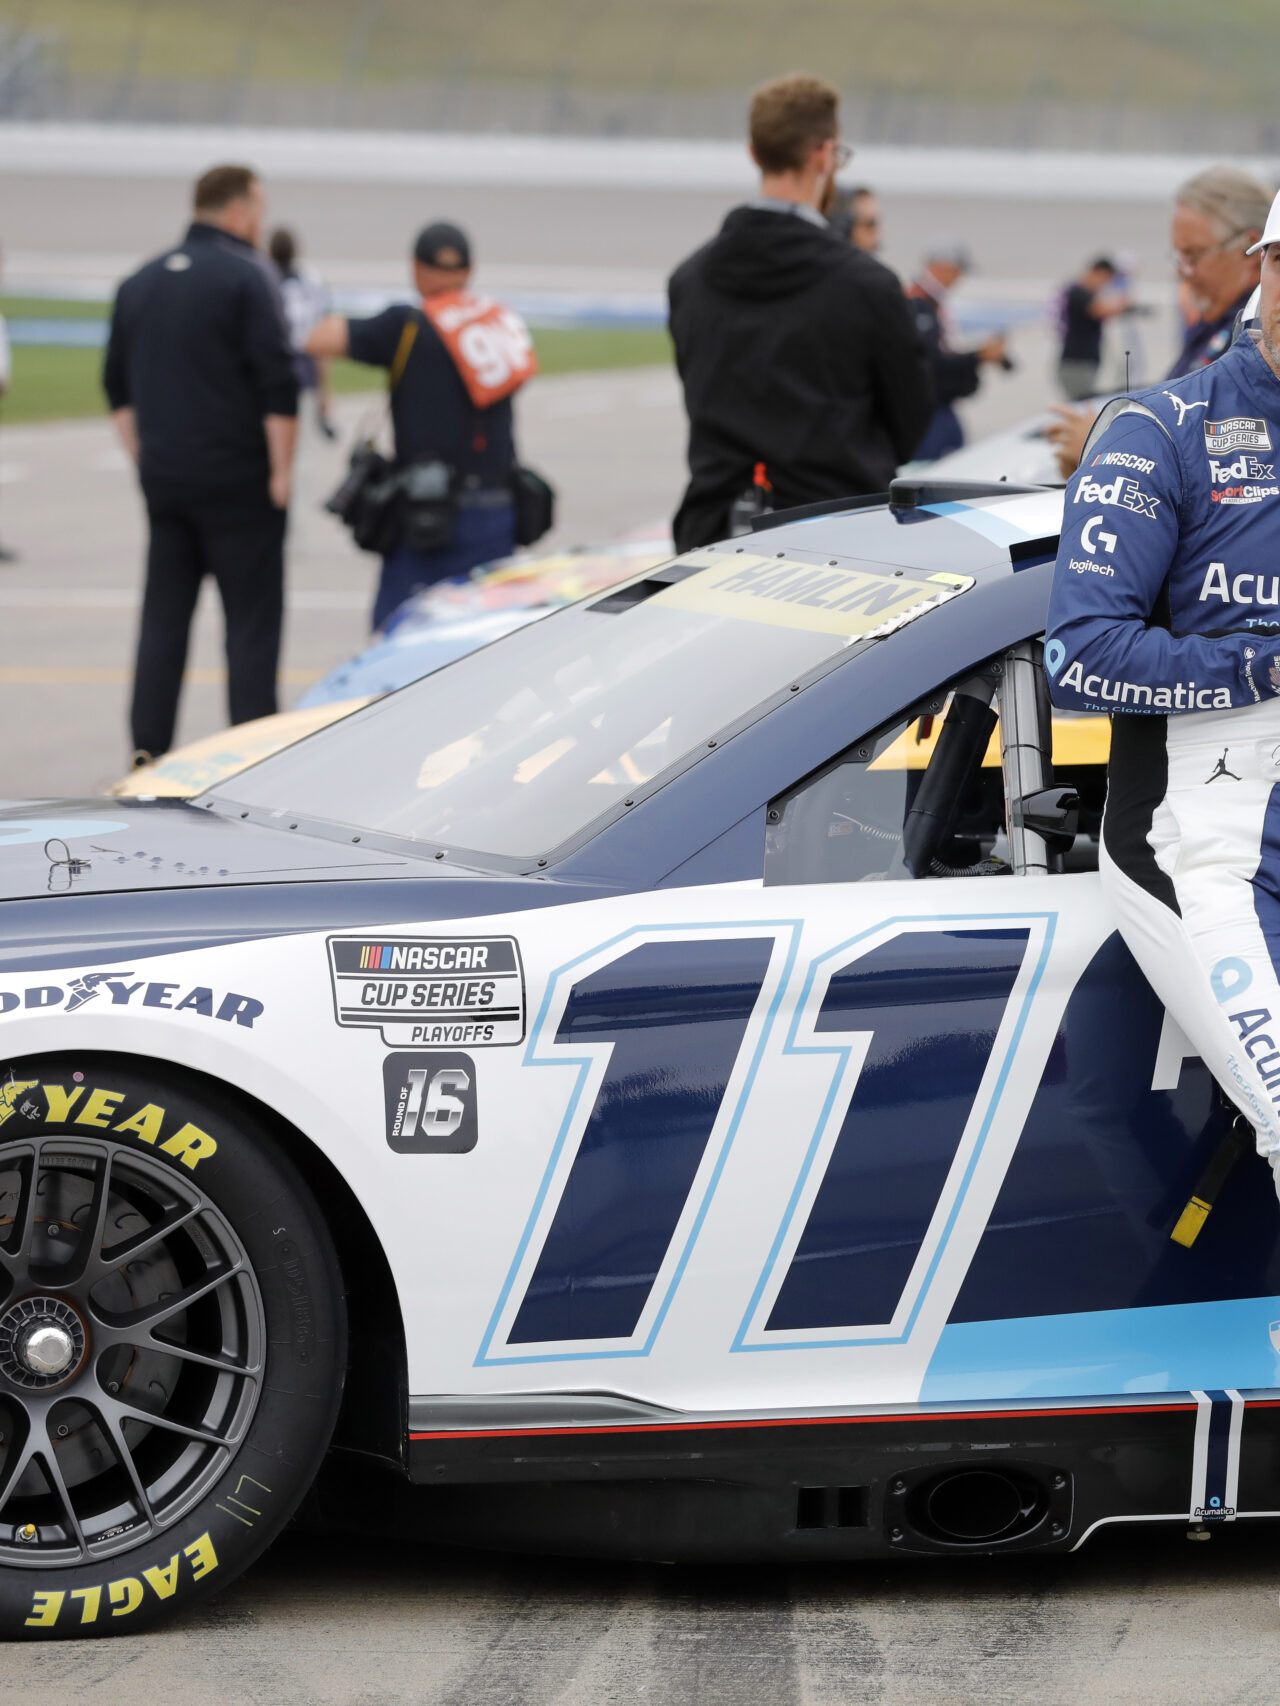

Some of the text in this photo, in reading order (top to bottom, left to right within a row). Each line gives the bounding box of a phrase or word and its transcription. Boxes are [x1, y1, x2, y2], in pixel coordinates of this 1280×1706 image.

[1220, 420, 1256, 434] NASCAR
[1212, 433, 1260, 448] CUP SERIES
[1101, 452, 1156, 474] NASCAR
[1208, 455, 1276, 483] FedEx
[1073, 474, 1161, 519] FedEx
[1068, 558, 1115, 577] logitech
[709, 561, 922, 616] HAMLIN
[1058, 660, 1233, 709] Acumatica
[1083, 702, 1109, 712] The
[1112, 706, 1151, 714] Cloud
[390, 946, 489, 970] NASCAR
[361, 982, 496, 1006] CUP SERIES
[412, 1025, 495, 1042] PLAYOFFS
[392, 1086, 410, 1137] ROUND OF
[401, 1069, 471, 1137] 16
[482, 916, 1052, 1360] 11
[1195, 1507, 1234, 1516] Acumatica
[24, 1531, 220, 1628] EAGLE
